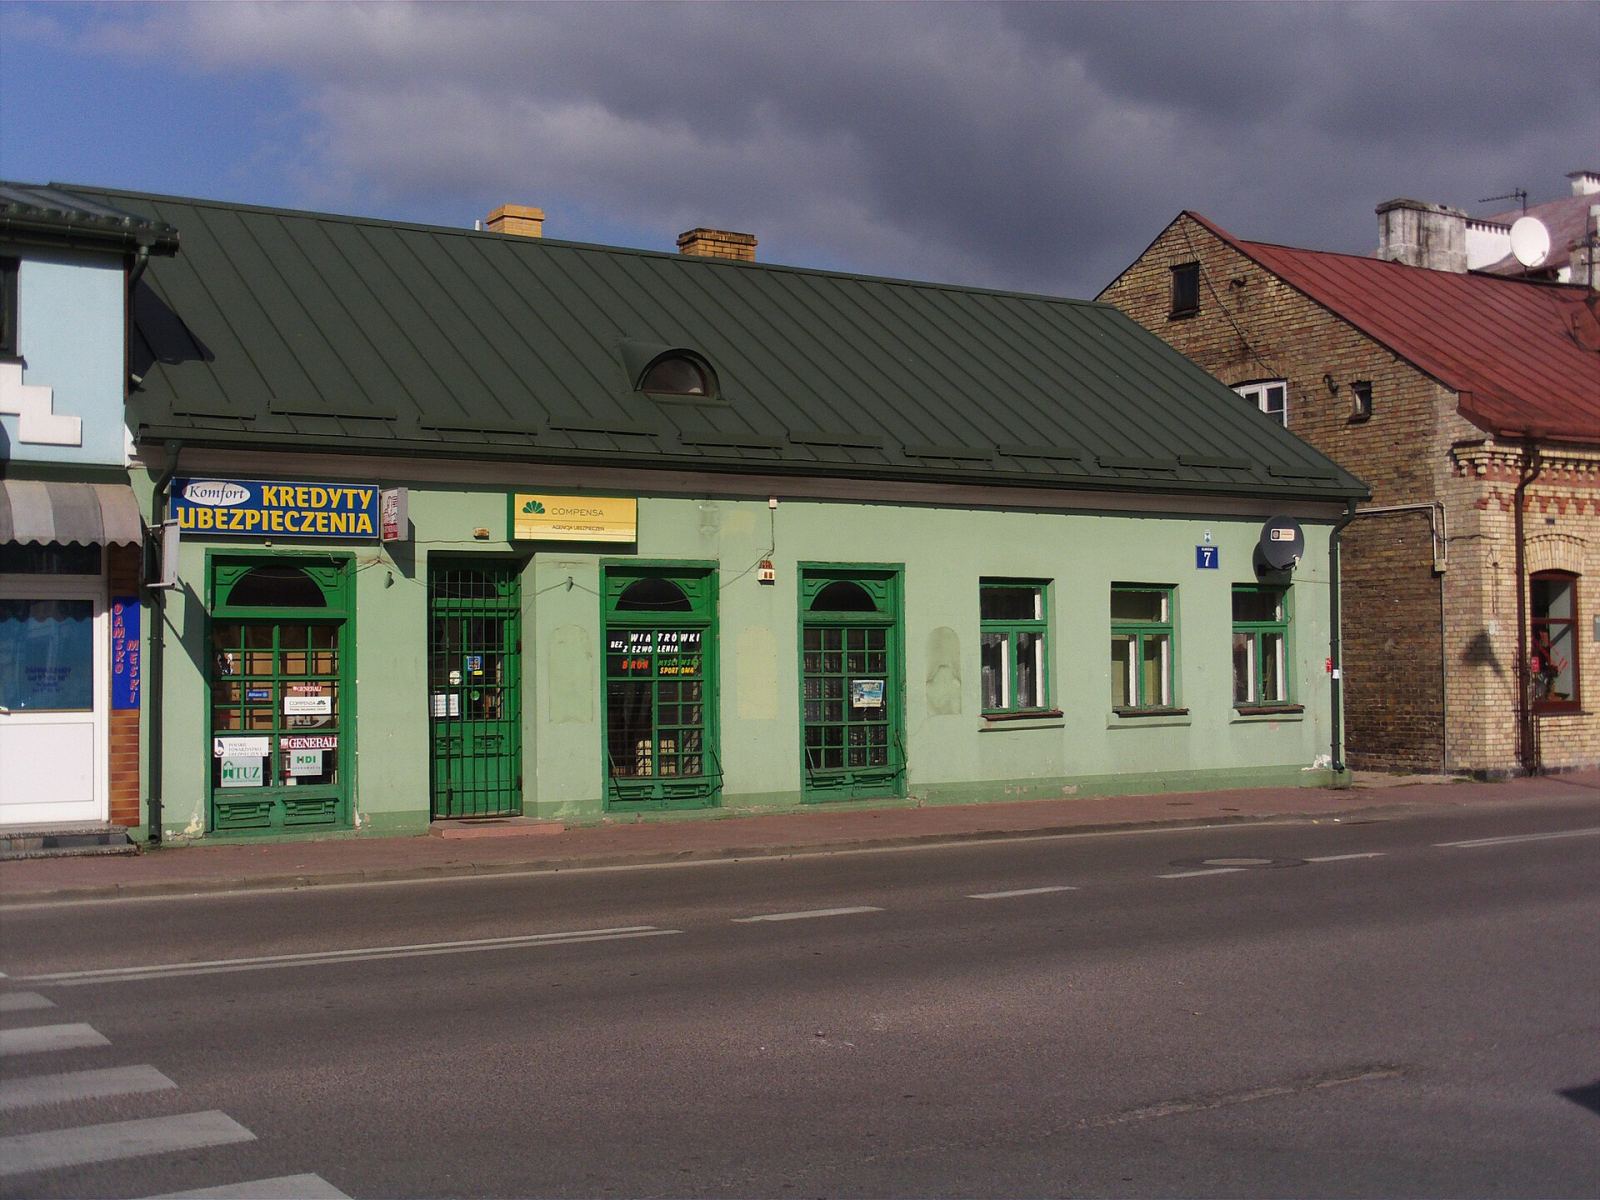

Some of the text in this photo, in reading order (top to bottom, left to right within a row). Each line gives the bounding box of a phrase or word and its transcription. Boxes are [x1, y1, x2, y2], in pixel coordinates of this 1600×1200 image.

[189, 482, 244, 505] Komfort
[261, 485, 373, 510] KREDYTY
[551, 507, 605, 517] COMPENSA
[176, 507, 373, 534] UBEZPIECZENIA
[1203, 551, 1211, 567] 7
[113, 602, 125, 674] DAMSKO
[610, 641, 624, 649] BEZ
[289, 737, 338, 749] GENERALI
[296, 755, 316, 764] HDI
[233, 766, 261, 779] TUZ
